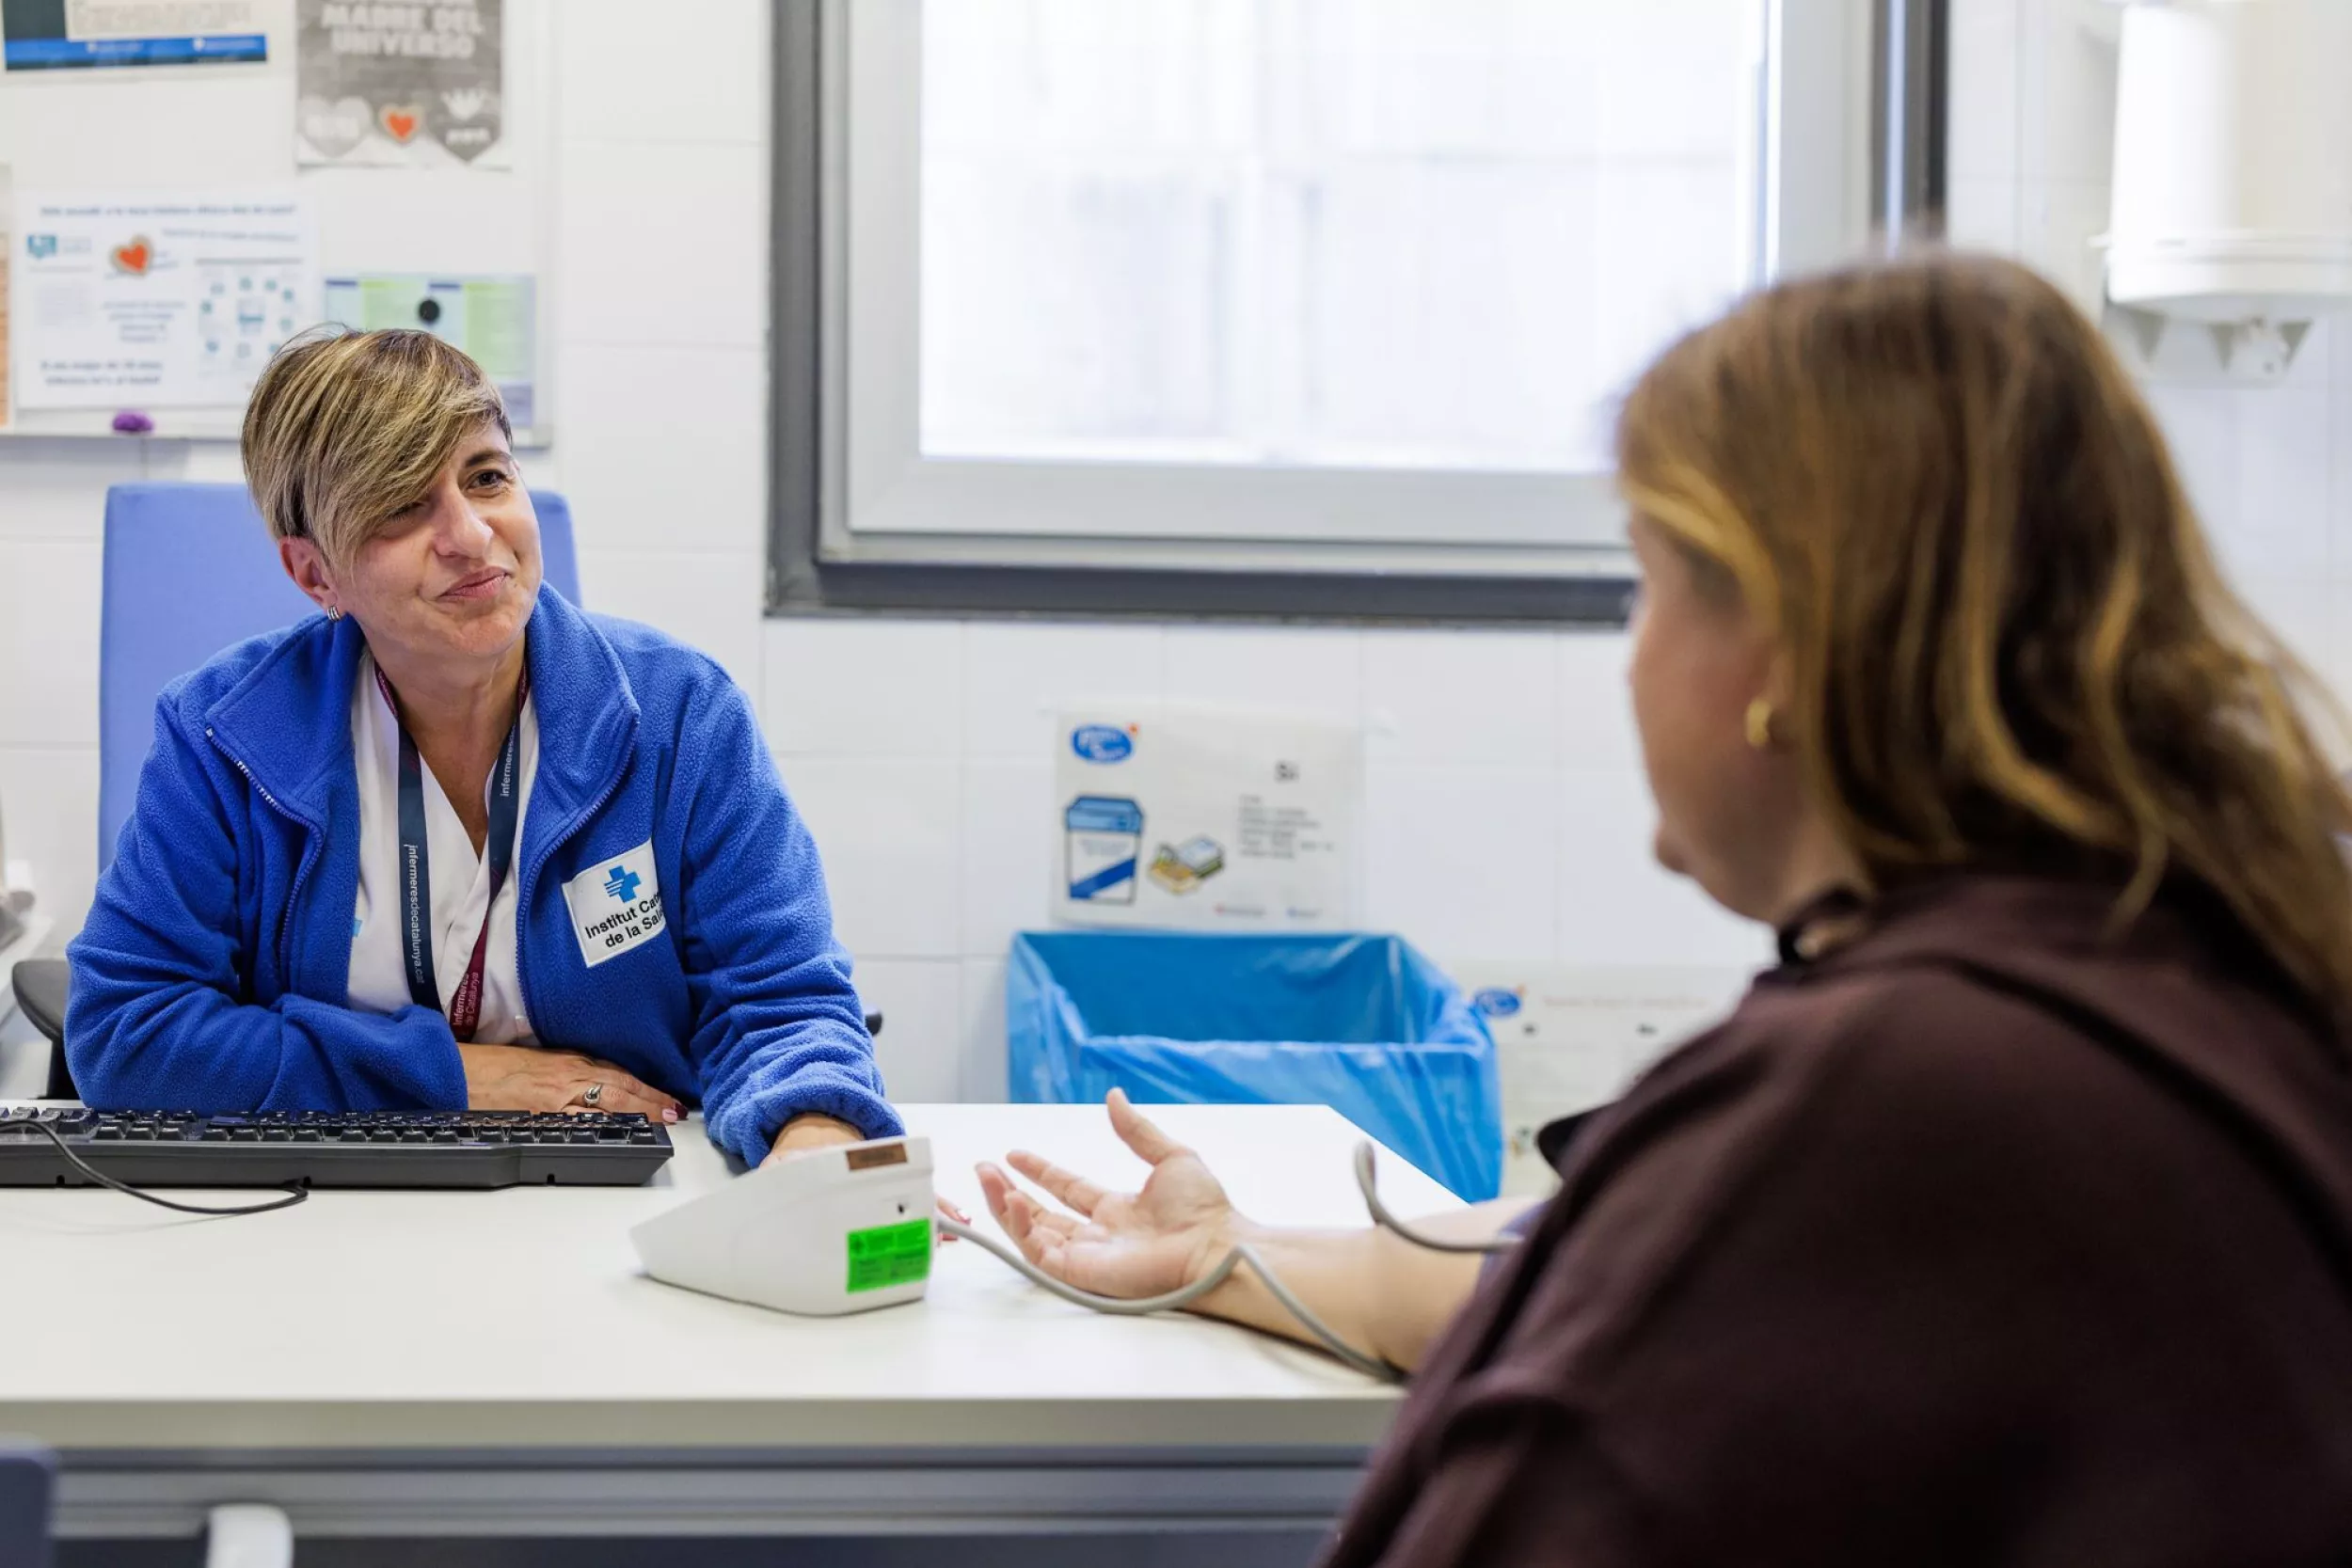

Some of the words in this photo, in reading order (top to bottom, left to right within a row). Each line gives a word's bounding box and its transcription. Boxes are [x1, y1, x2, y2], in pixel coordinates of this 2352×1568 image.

[332, 29, 476, 59] UNIVERSO
[585, 907, 637, 939] Institut
[639, 892, 661, 913] Cat
[605, 931, 625, 948] de
[626, 925, 642, 939] la
